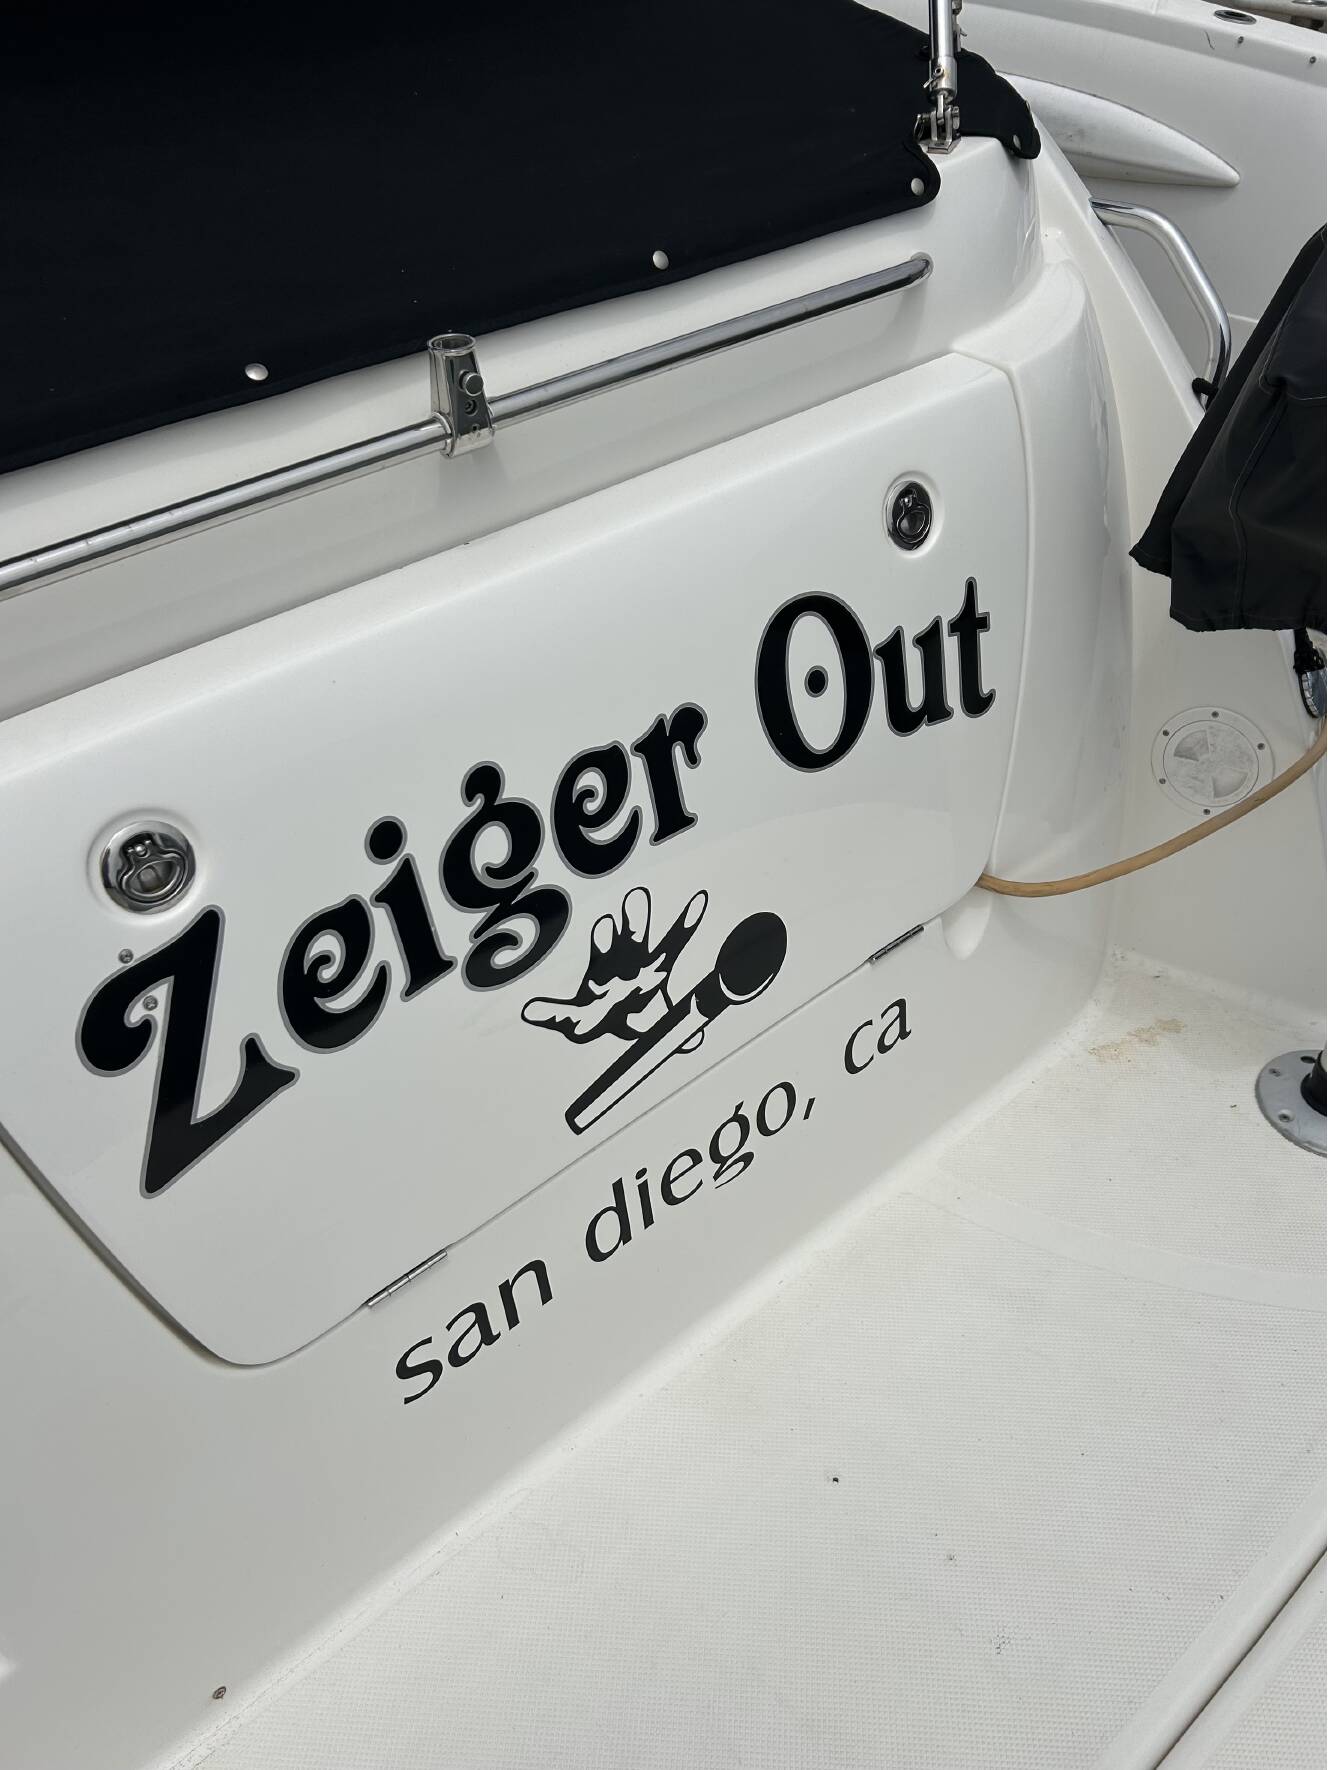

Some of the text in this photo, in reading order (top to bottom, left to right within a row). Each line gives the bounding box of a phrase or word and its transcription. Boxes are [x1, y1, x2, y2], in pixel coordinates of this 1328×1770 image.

[74, 575, 998, 1201] Zeiger Out
[394, 997, 913, 1406] san diego, ca
